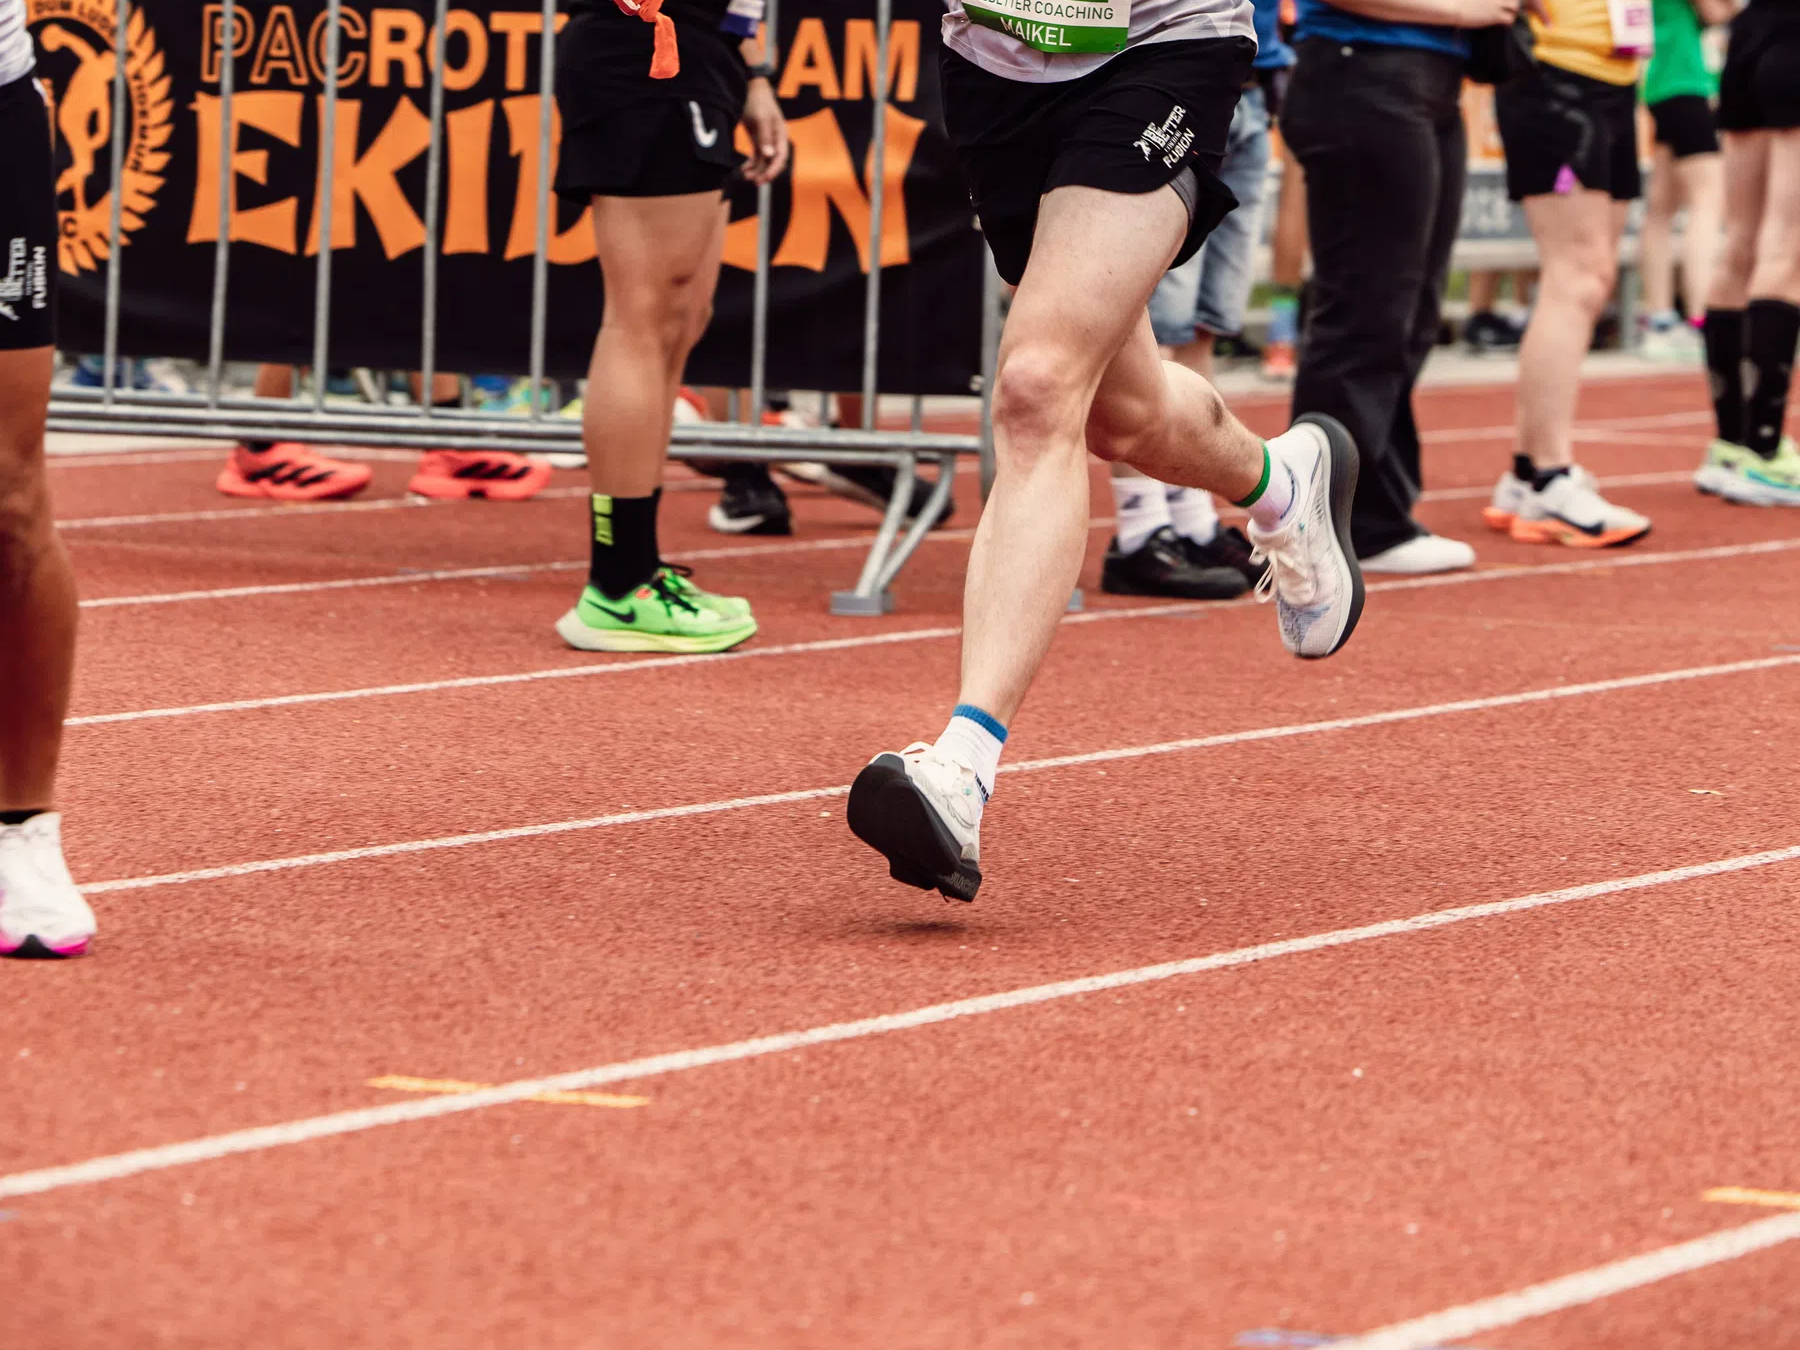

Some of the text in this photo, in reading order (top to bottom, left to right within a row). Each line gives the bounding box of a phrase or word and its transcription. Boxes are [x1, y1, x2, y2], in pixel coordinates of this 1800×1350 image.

[1034, 0, 1114, 20] COACHING
[1000, 16, 1072, 46] MAIKEL
[1152, 104, 1187, 148] BETTER
[1162, 127, 1195, 169] FUSION
